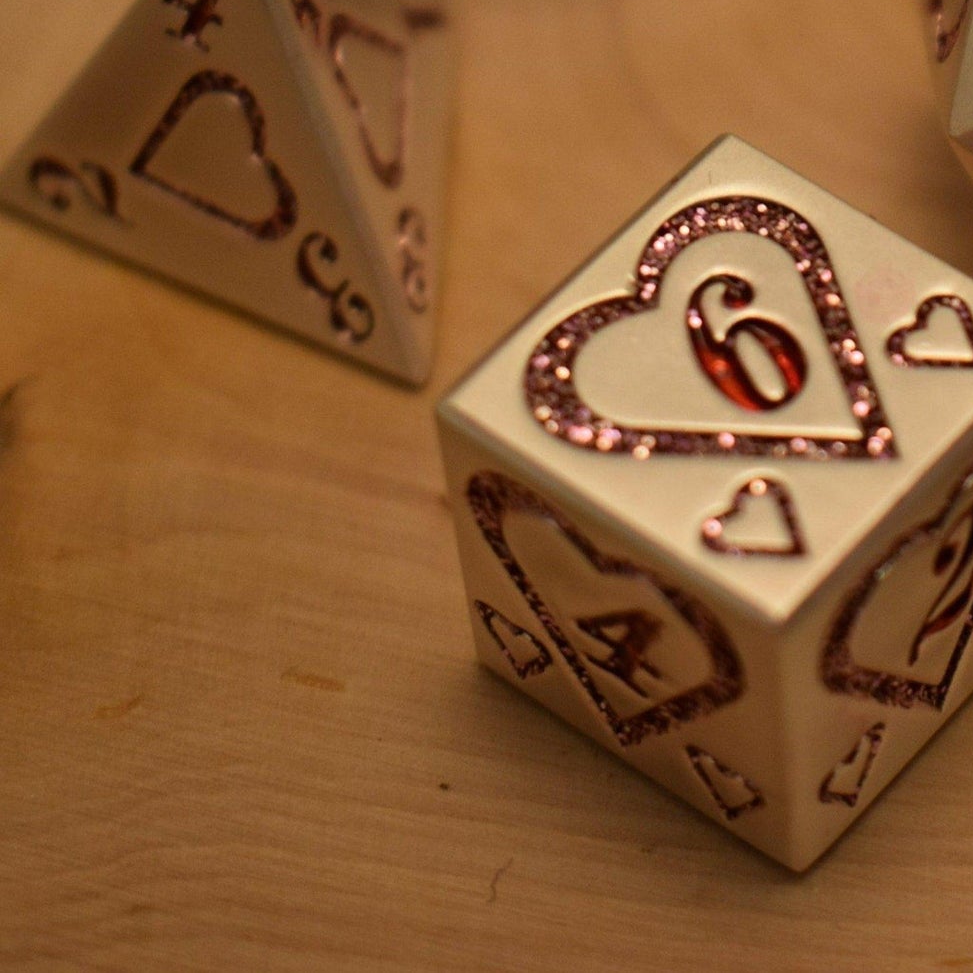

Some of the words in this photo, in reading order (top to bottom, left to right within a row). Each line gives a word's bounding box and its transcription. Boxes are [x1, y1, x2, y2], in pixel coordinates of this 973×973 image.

[28, 153, 128, 227] 2
[296, 230, 376, 345] 3
[684, 273, 808, 413] 6
[573, 610, 667, 699] 4
